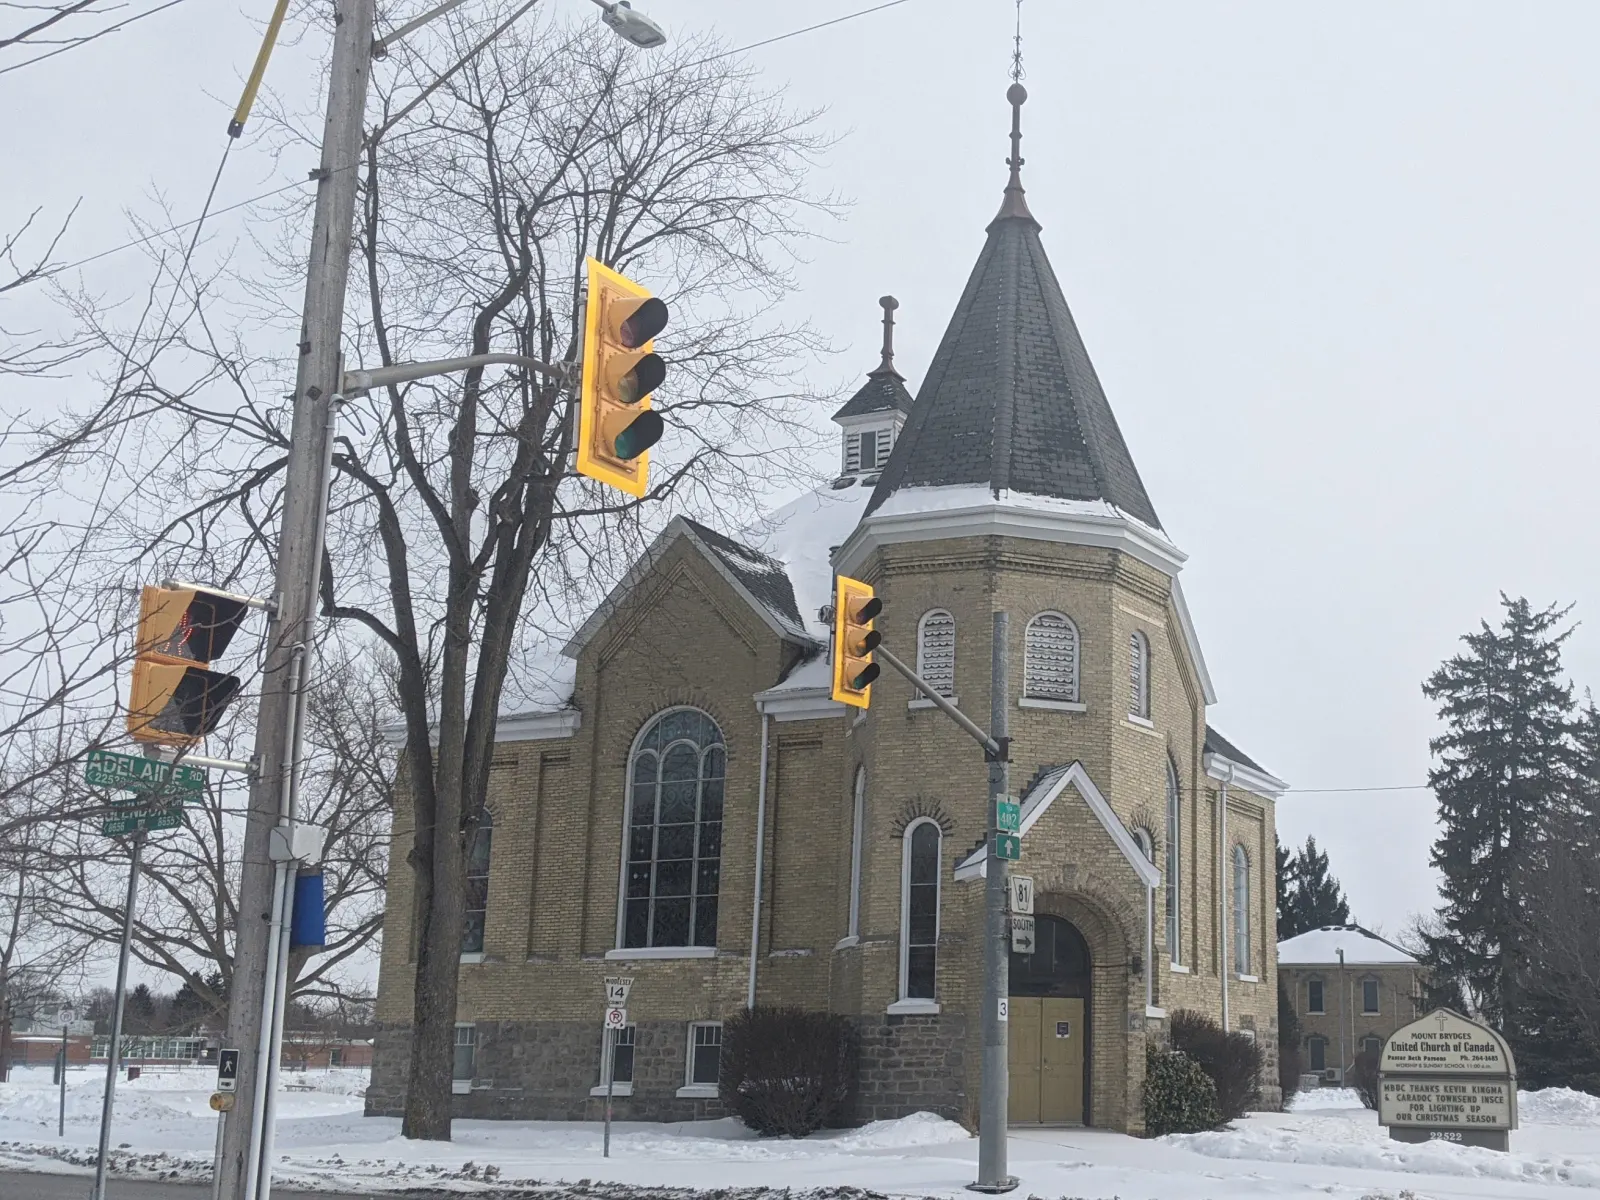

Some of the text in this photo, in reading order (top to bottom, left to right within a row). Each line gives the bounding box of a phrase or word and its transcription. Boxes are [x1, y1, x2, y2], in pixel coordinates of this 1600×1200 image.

[190, 770, 202, 781] RD
[1001, 812, 1017, 828] 402
[1018, 884, 1028, 903] 81
[1012, 918, 1034, 931] SOUTH
[610, 986, 624, 998] 14
[1000, 1002, 1007, 1016] 3
[1391, 1041, 1495, 1053] United Church of Canada
[1384, 1084, 1503, 1095] MBUC THANKS KEVIN KINGMA
[1396, 1094, 1432, 1102] CARADOC
[1435, 1095, 1478, 1103] TOWNSEND
[1481, 1096, 1504, 1104] INSCE
[1409, 1103, 1481, 1113] FOR LIGHTING UP
[1396, 1113, 1497, 1123] OUR CHRISTMAS SEASON
[1430, 1132, 1462, 1141] 22522
